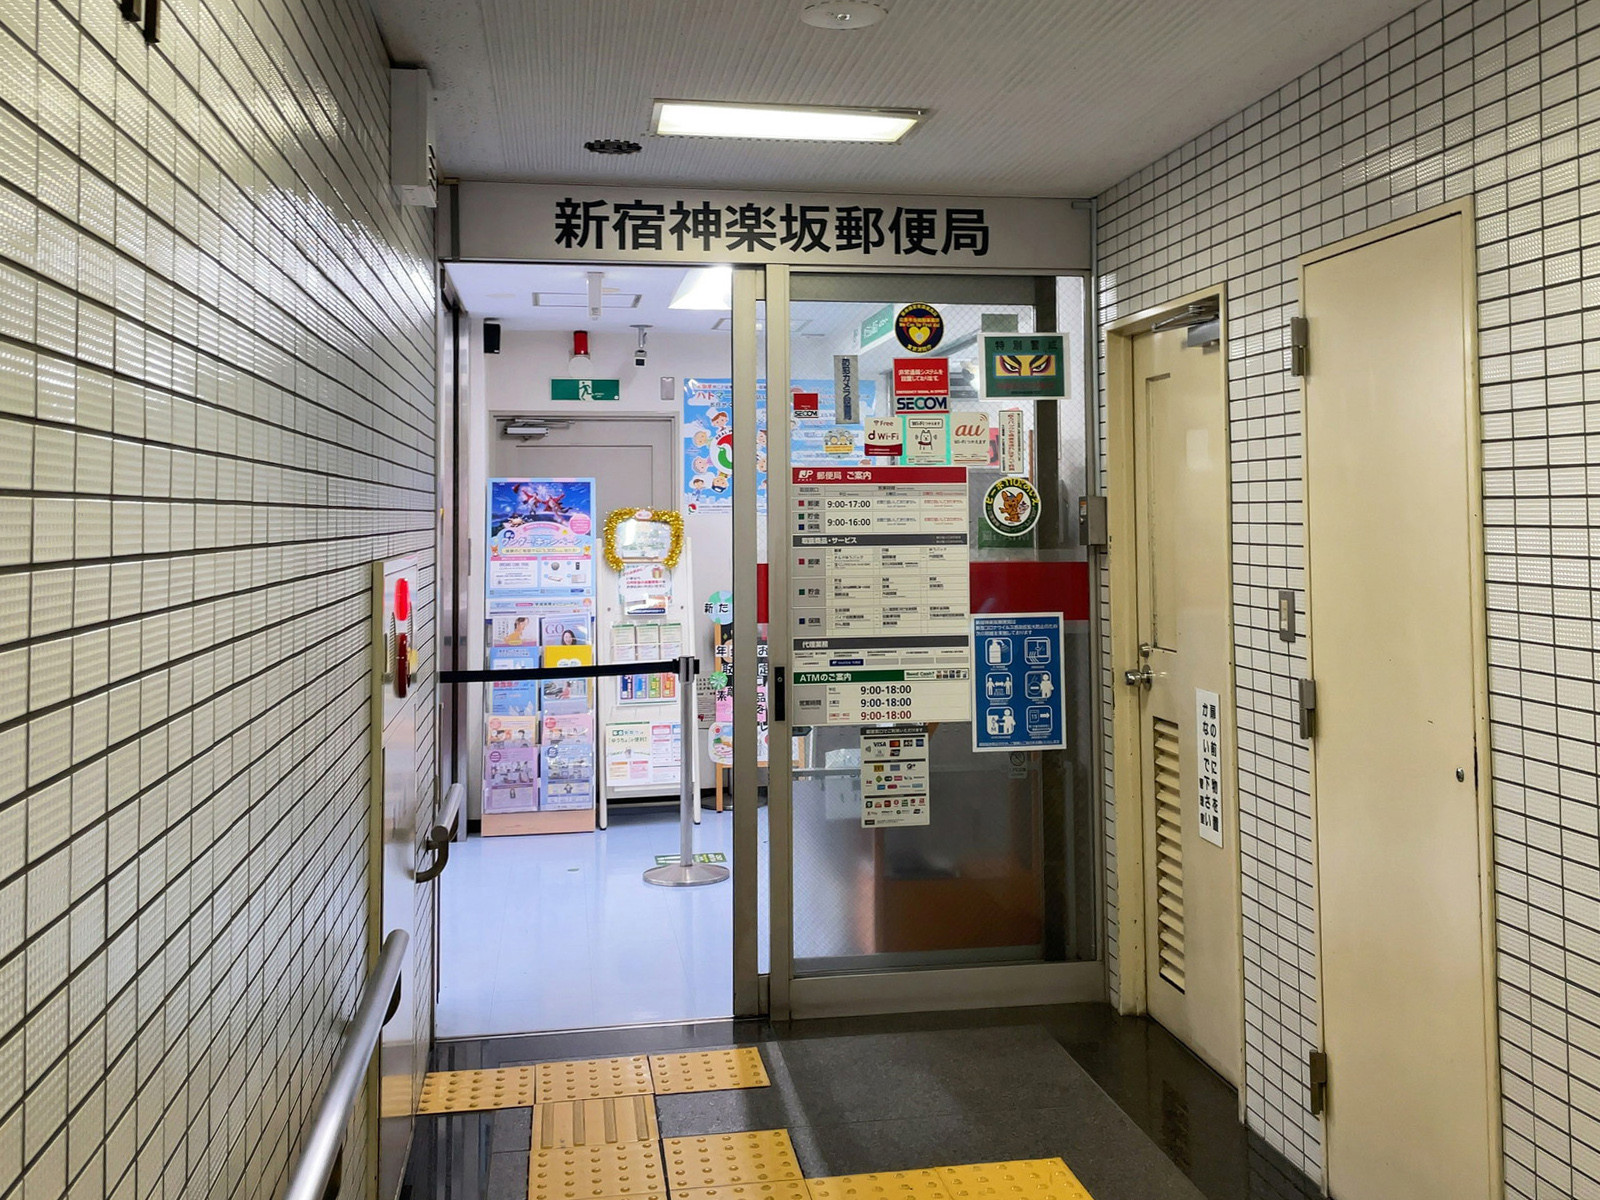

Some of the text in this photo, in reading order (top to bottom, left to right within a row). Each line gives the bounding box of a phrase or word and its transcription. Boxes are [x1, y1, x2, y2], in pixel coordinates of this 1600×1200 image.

[555, 197, 990, 256] 新宿神楽坂郵便局
[896, 396, 948, 410] SECOM
[868, 429, 899, 440] d Wi-Fi
[954, 424, 985, 437] au
[816, 471, 872, 480] 郵便局 ご案内
[827, 500, 871, 508] 9:00-17:00
[827, 518, 871, 526] 9:00-16:00
[799, 673, 852, 682] ATMのご案内
[860, 685, 912, 695] 9:00-18:00
[860, 697, 912, 708] 9:00-18:00
[860, 710, 912, 721] 9:00-18:00
[1202, 703, 1211, 827] かないで下さい
[1209, 704, 1219, 832] 扉の前に物を置
